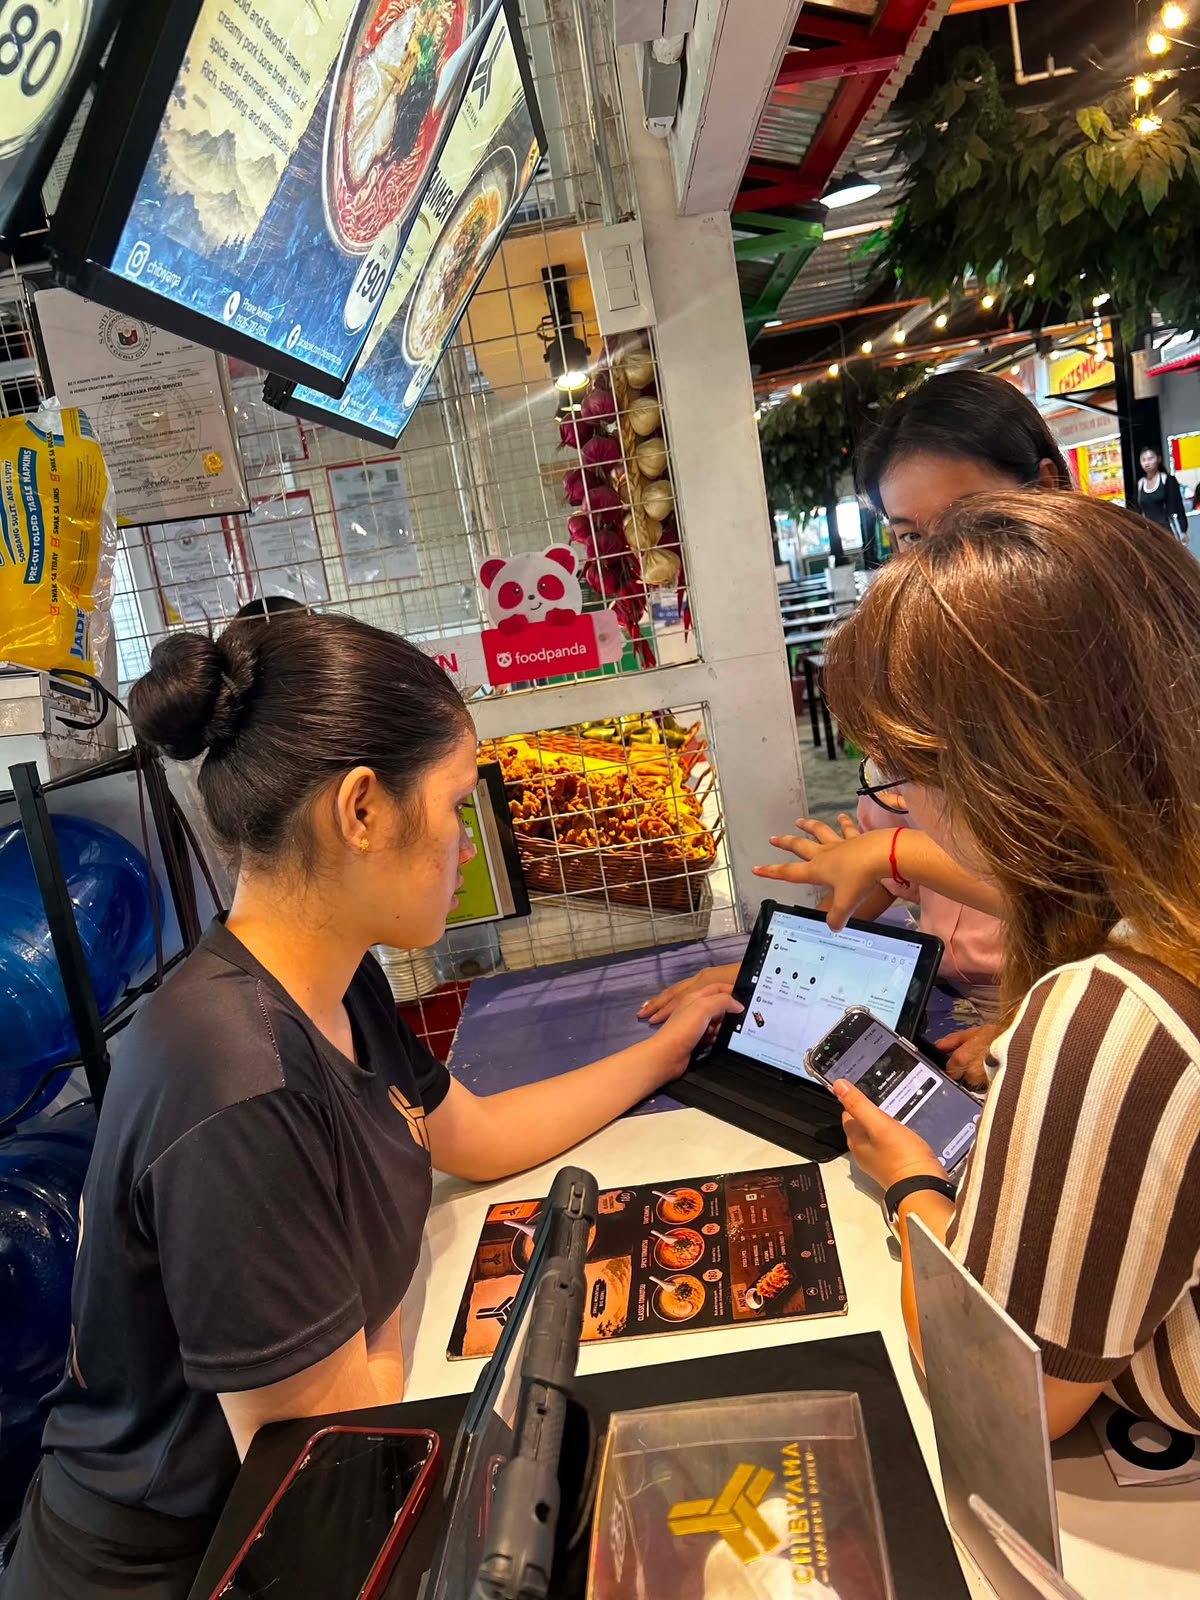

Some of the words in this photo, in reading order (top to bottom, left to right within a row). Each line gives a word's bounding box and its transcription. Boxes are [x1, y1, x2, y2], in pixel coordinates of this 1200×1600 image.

[0, 0, 62, 96] 80
[218, 10, 245, 45] creamy
[242, 38, 260, 60] pork
[257, 48, 274, 75] bone
[290, 86, 302, 107] kick
[300, 100, 308, 112] of
[249, 9, 265, 29] and
[262, 19, 288, 56] flavorful
[284, 50, 302, 71] ramen
[300, 67, 311, 86] with
[209, 37, 229, 66] spice,
[230, 58, 244, 77] and
[243, 70, 269, 102] aromatic
[201, 59, 217, 89] Rich,
[248, 109, 261, 126] and
[146, 261, 182, 289] chibiyama
[356, 258, 387, 304] 190
[242, 297, 259, 316] Phone
[147, 384, 161, 393] FOOD
[162, 382, 183, 391] SERVICES
[46, 431, 54, 448] BULSA
[22, 449, 32, 482] NAPKINS
[49, 458, 57, 472] SWAK
[6, 485, 15, 501] ANG
[25, 485, 37, 512] TABLE
[52, 488, 60, 504] LINIS
[53, 505, 60, 515] SA
[12, 528, 26, 562] SOBRANG
[31, 515, 41, 546] FOLDED
[28, 549, 40, 581] PRE-CUT
[515, 642, 587, 664] foodpanda
[738, 1298, 746, 1308] ADD
[781, 1442, 815, 1585] CHIBIYAMA
